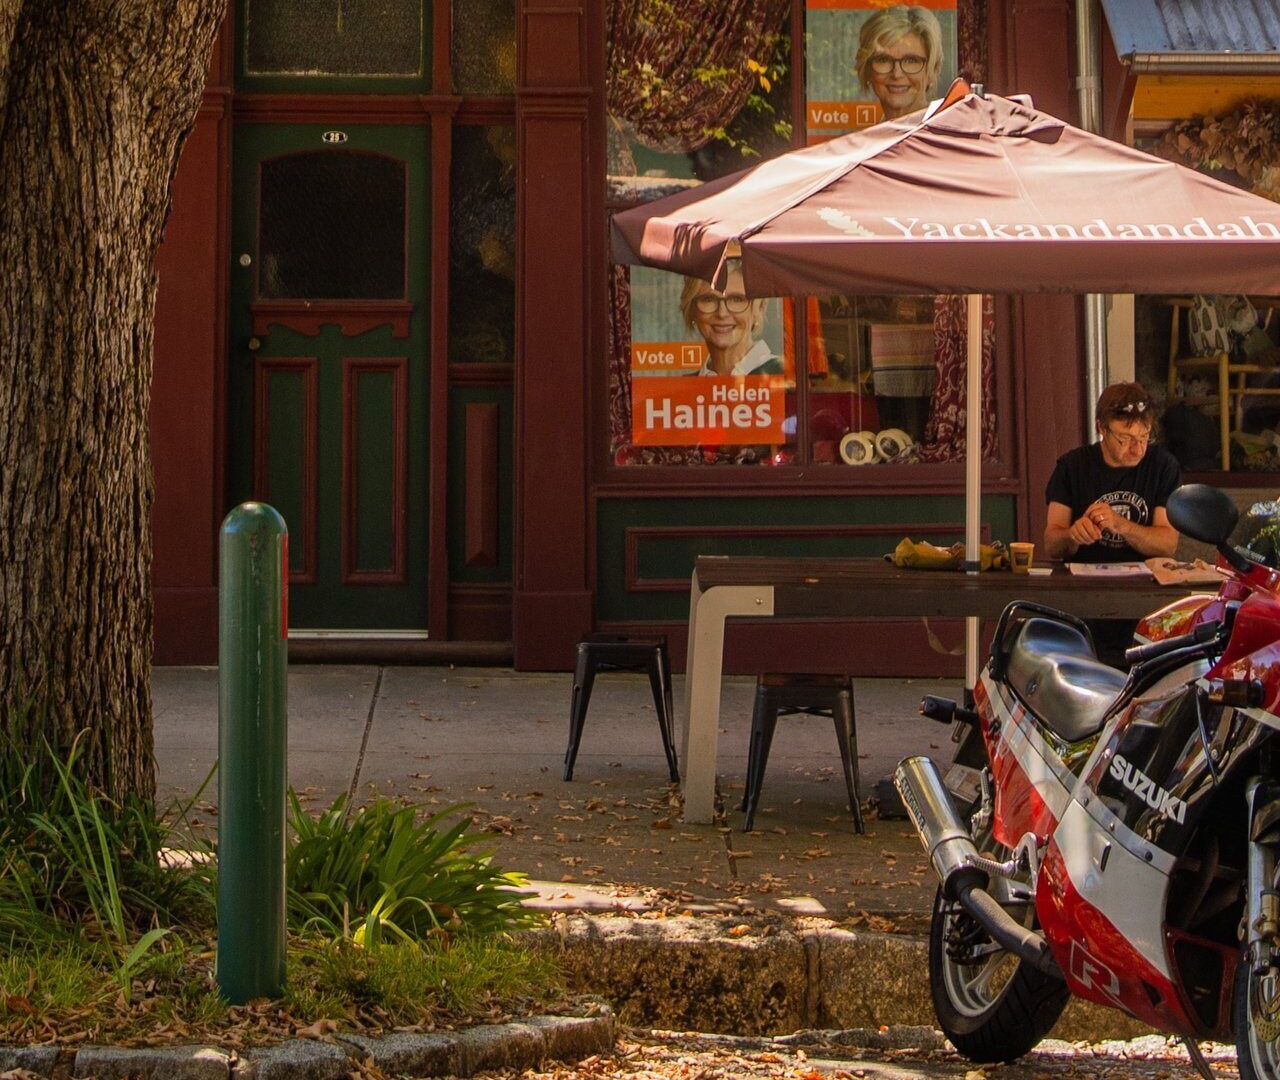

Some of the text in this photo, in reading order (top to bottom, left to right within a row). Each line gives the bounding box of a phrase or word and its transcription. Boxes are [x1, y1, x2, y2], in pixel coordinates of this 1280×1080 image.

[811, 109, 850, 124] Vote
[635, 350, 676, 365] Vote
[712, 384, 770, 402] Helen
[645, 394, 773, 430] Haines
[1109, 753, 1188, 825] SUZUKI
